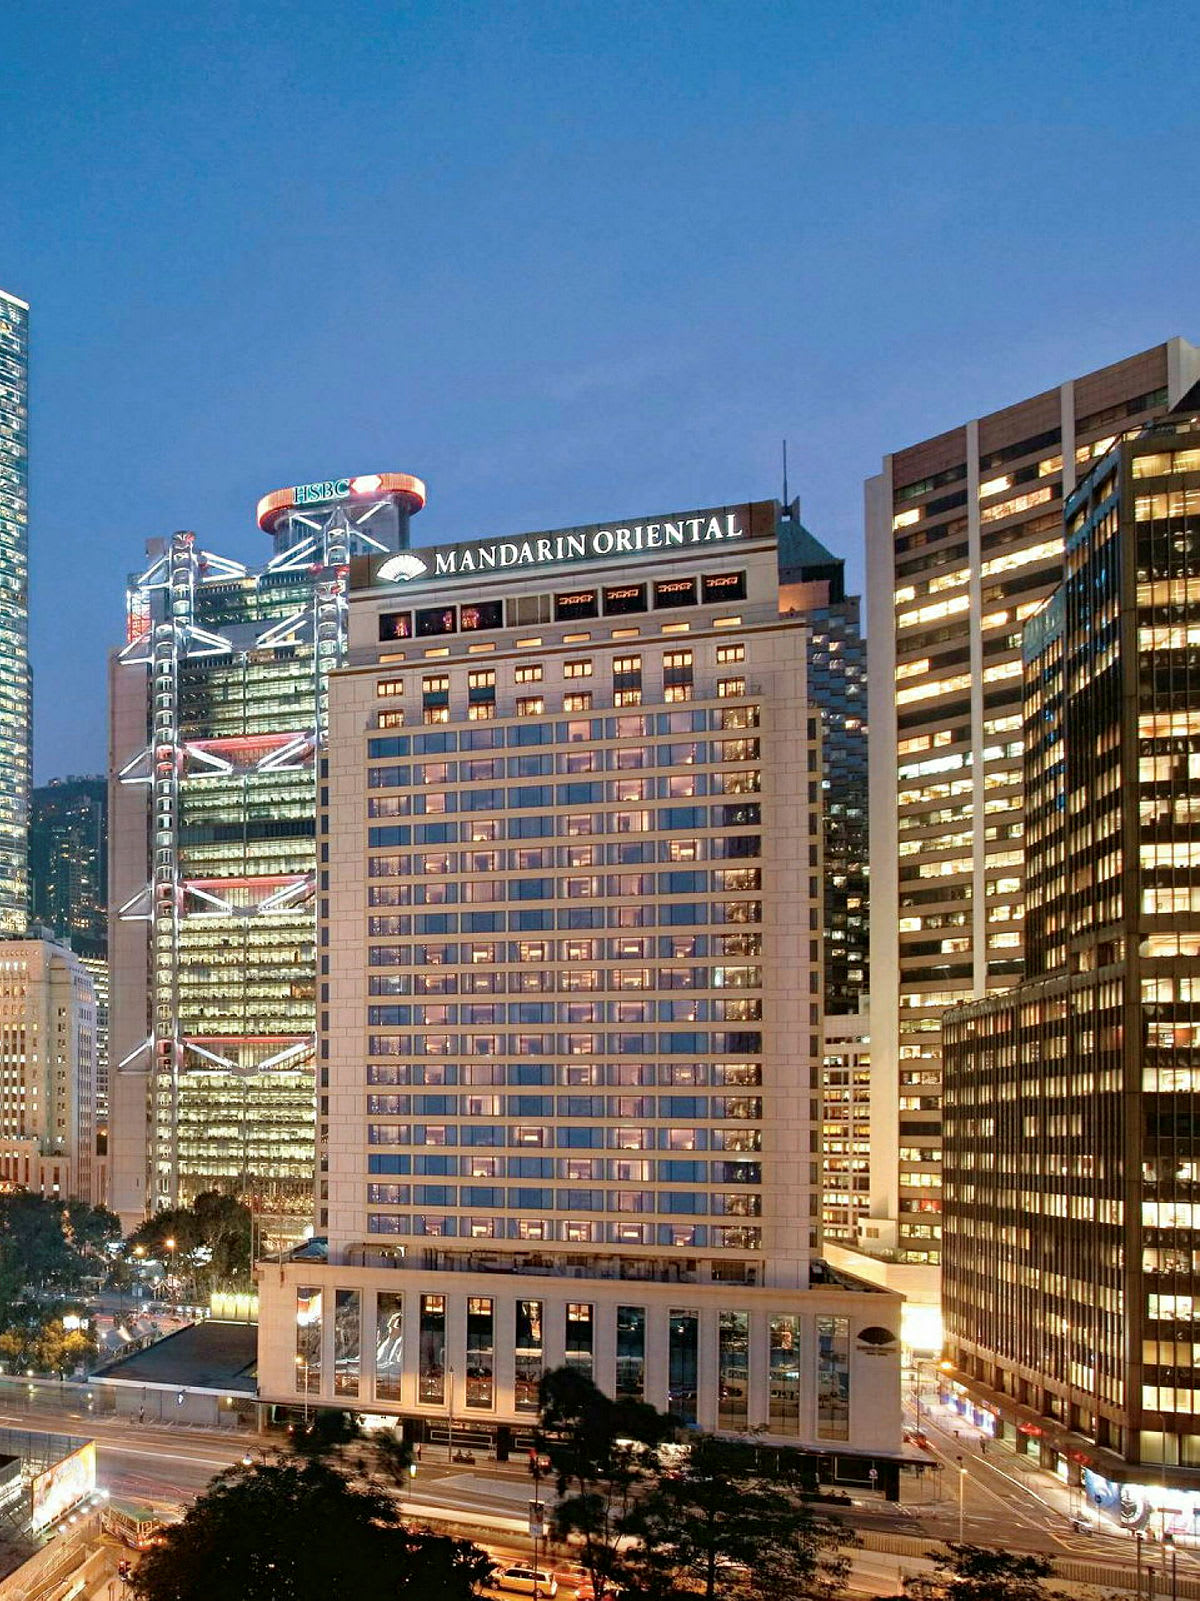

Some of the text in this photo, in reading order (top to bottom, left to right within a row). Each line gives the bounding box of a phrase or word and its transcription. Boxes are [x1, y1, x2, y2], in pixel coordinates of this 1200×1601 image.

[293, 479, 350, 504] HSBC
[434, 514, 743, 575] MANDARIN ORIENTAL
